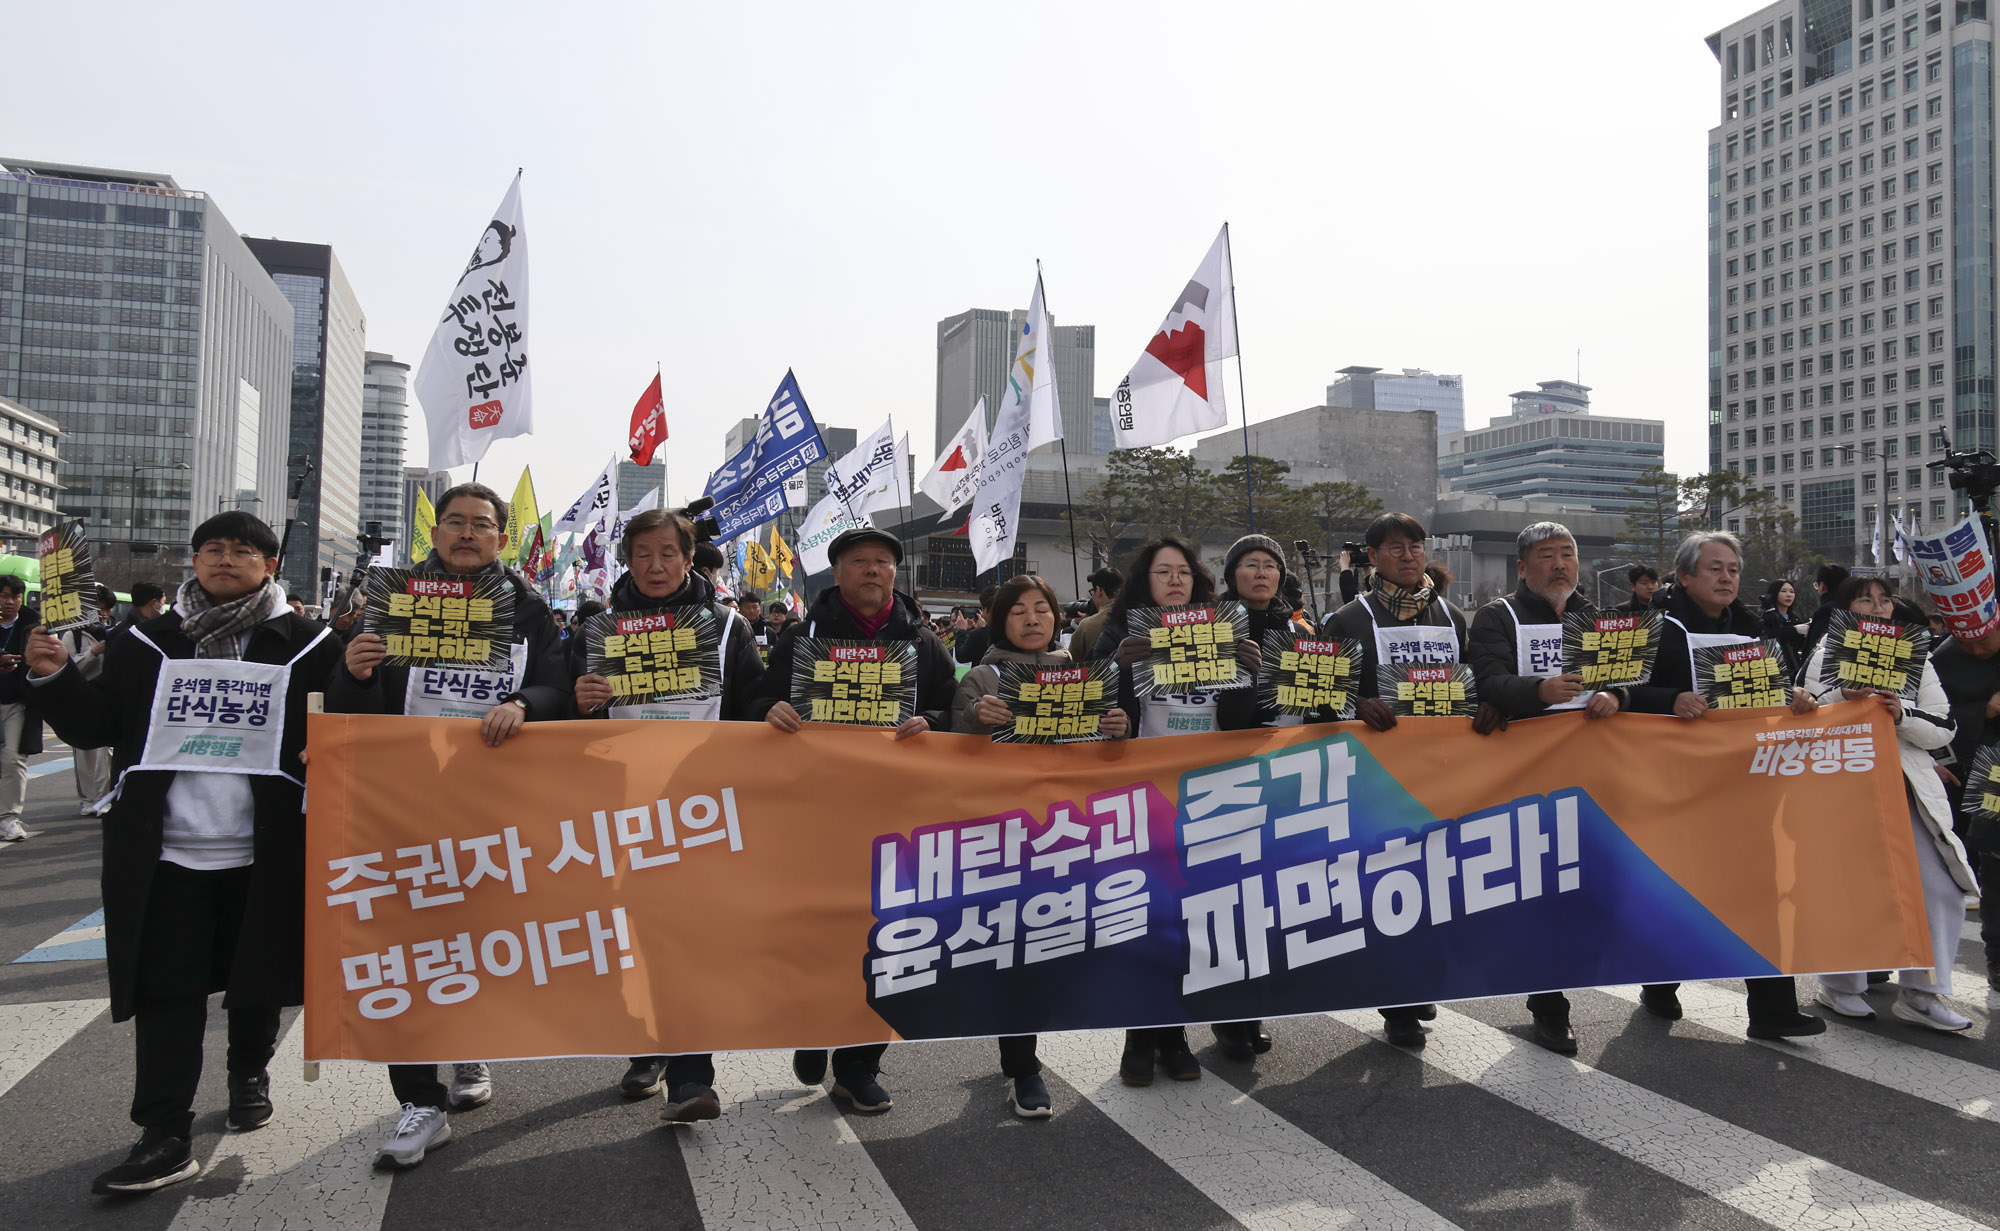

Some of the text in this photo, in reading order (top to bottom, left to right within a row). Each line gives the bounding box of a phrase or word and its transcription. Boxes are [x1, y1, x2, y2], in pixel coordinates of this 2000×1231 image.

[482, 279, 528, 387] 전봉준
[443, 294, 500, 399] 투쟁단
[1911, 522, 1978, 562] 석열
[413, 581, 464, 595] 내란수괴
[389, 592, 494, 621] 윤석열을
[1167, 609, 1208, 624] 내란수괴
[622, 616, 667, 632] 내란수괴
[1150, 622, 1234, 648] 윤석열을
[1600, 618, 1633, 630] 내란수괴
[1862, 622, 1896, 636] 내란수괴
[386, 634, 491, 661] 파면하라
[604, 627, 697, 658] 윤석열을
[1299, 641, 1333, 653] 내란수괴
[1389, 641, 1454, 653] 윤석열 즉각파면
[1530, 638, 1562, 651] 윤석열
[1582, 629, 1650, 651] 윤석열을
[1843, 629, 1914, 660] 윤석열을
[836, 648, 878, 660] 내란수괴
[1280, 651, 1351, 677] 윤석열을
[1728, 648, 1761, 661] 내란수괴
[607, 666, 701, 697] 파면하라
[814, 660, 902, 684] 윤석열을
[1041, 669, 1082, 682] 내란수괴
[1153, 658, 1237, 685] 파면하라
[1413, 669, 1446, 680] 내란수괴
[1581, 660, 1643, 684] 파면하라
[1714, 657, 1780, 683] 윤석열을
[1838, 661, 1908, 689] 파면하라
[172, 678, 272, 698] 윤석열 즉각파면
[423, 669, 513, 701] 단식농성
[1018, 680, 1104, 702] 윤석열을
[1276, 685, 1347, 710] 파면하라
[1397, 682, 1466, 701] 윤석열을
[167, 695, 269, 726] 단식농성
[811, 699, 901, 722] 파면하라
[1014, 714, 1101, 736] 파면하라
[1749, 737, 1876, 776] 비상행동
[1182, 741, 1357, 867] 즉각
[326, 786, 744, 921] 주권자 시민의
[880, 788, 1150, 910] 내란수괴
[1181, 795, 1581, 996] 파면하라!
[871, 868, 1150, 999] 윤석열을
[340, 906, 635, 1020] 명령이다!
